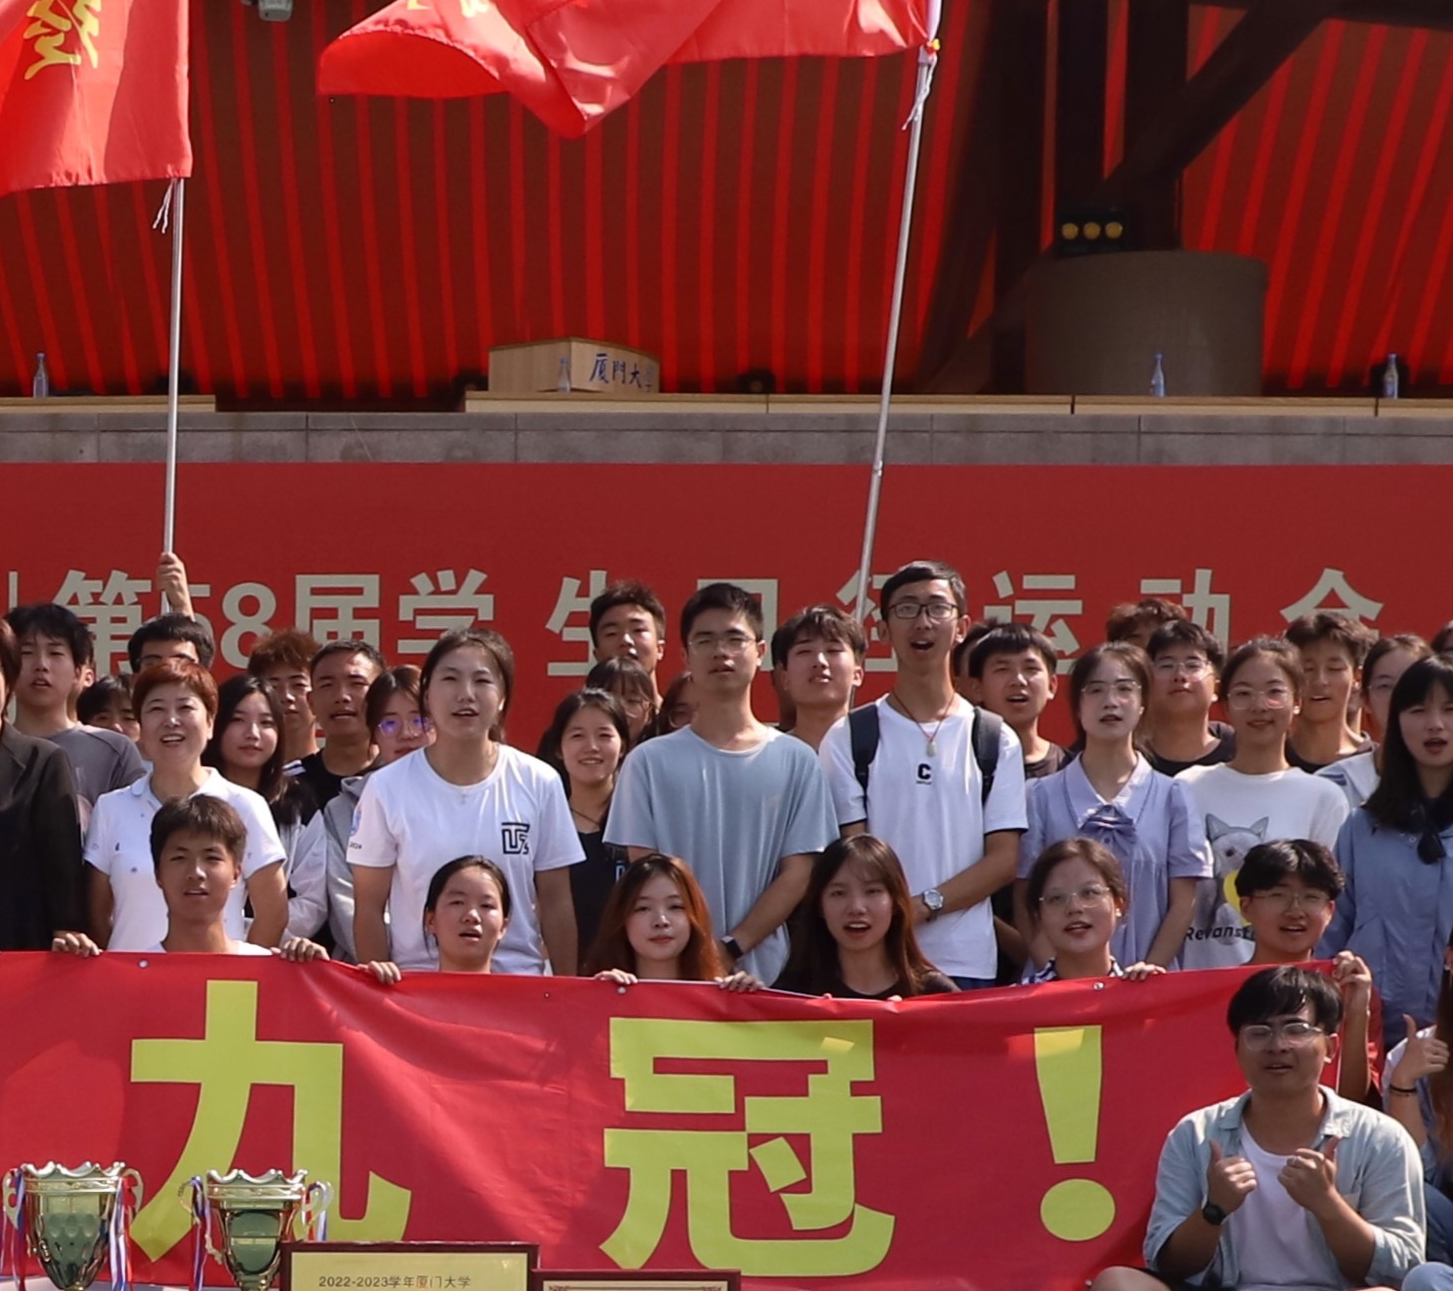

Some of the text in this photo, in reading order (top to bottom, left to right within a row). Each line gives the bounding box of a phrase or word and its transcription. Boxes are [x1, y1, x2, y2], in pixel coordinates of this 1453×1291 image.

[318, 1275, 472, 1290] 2022-2023学年厦门大学
